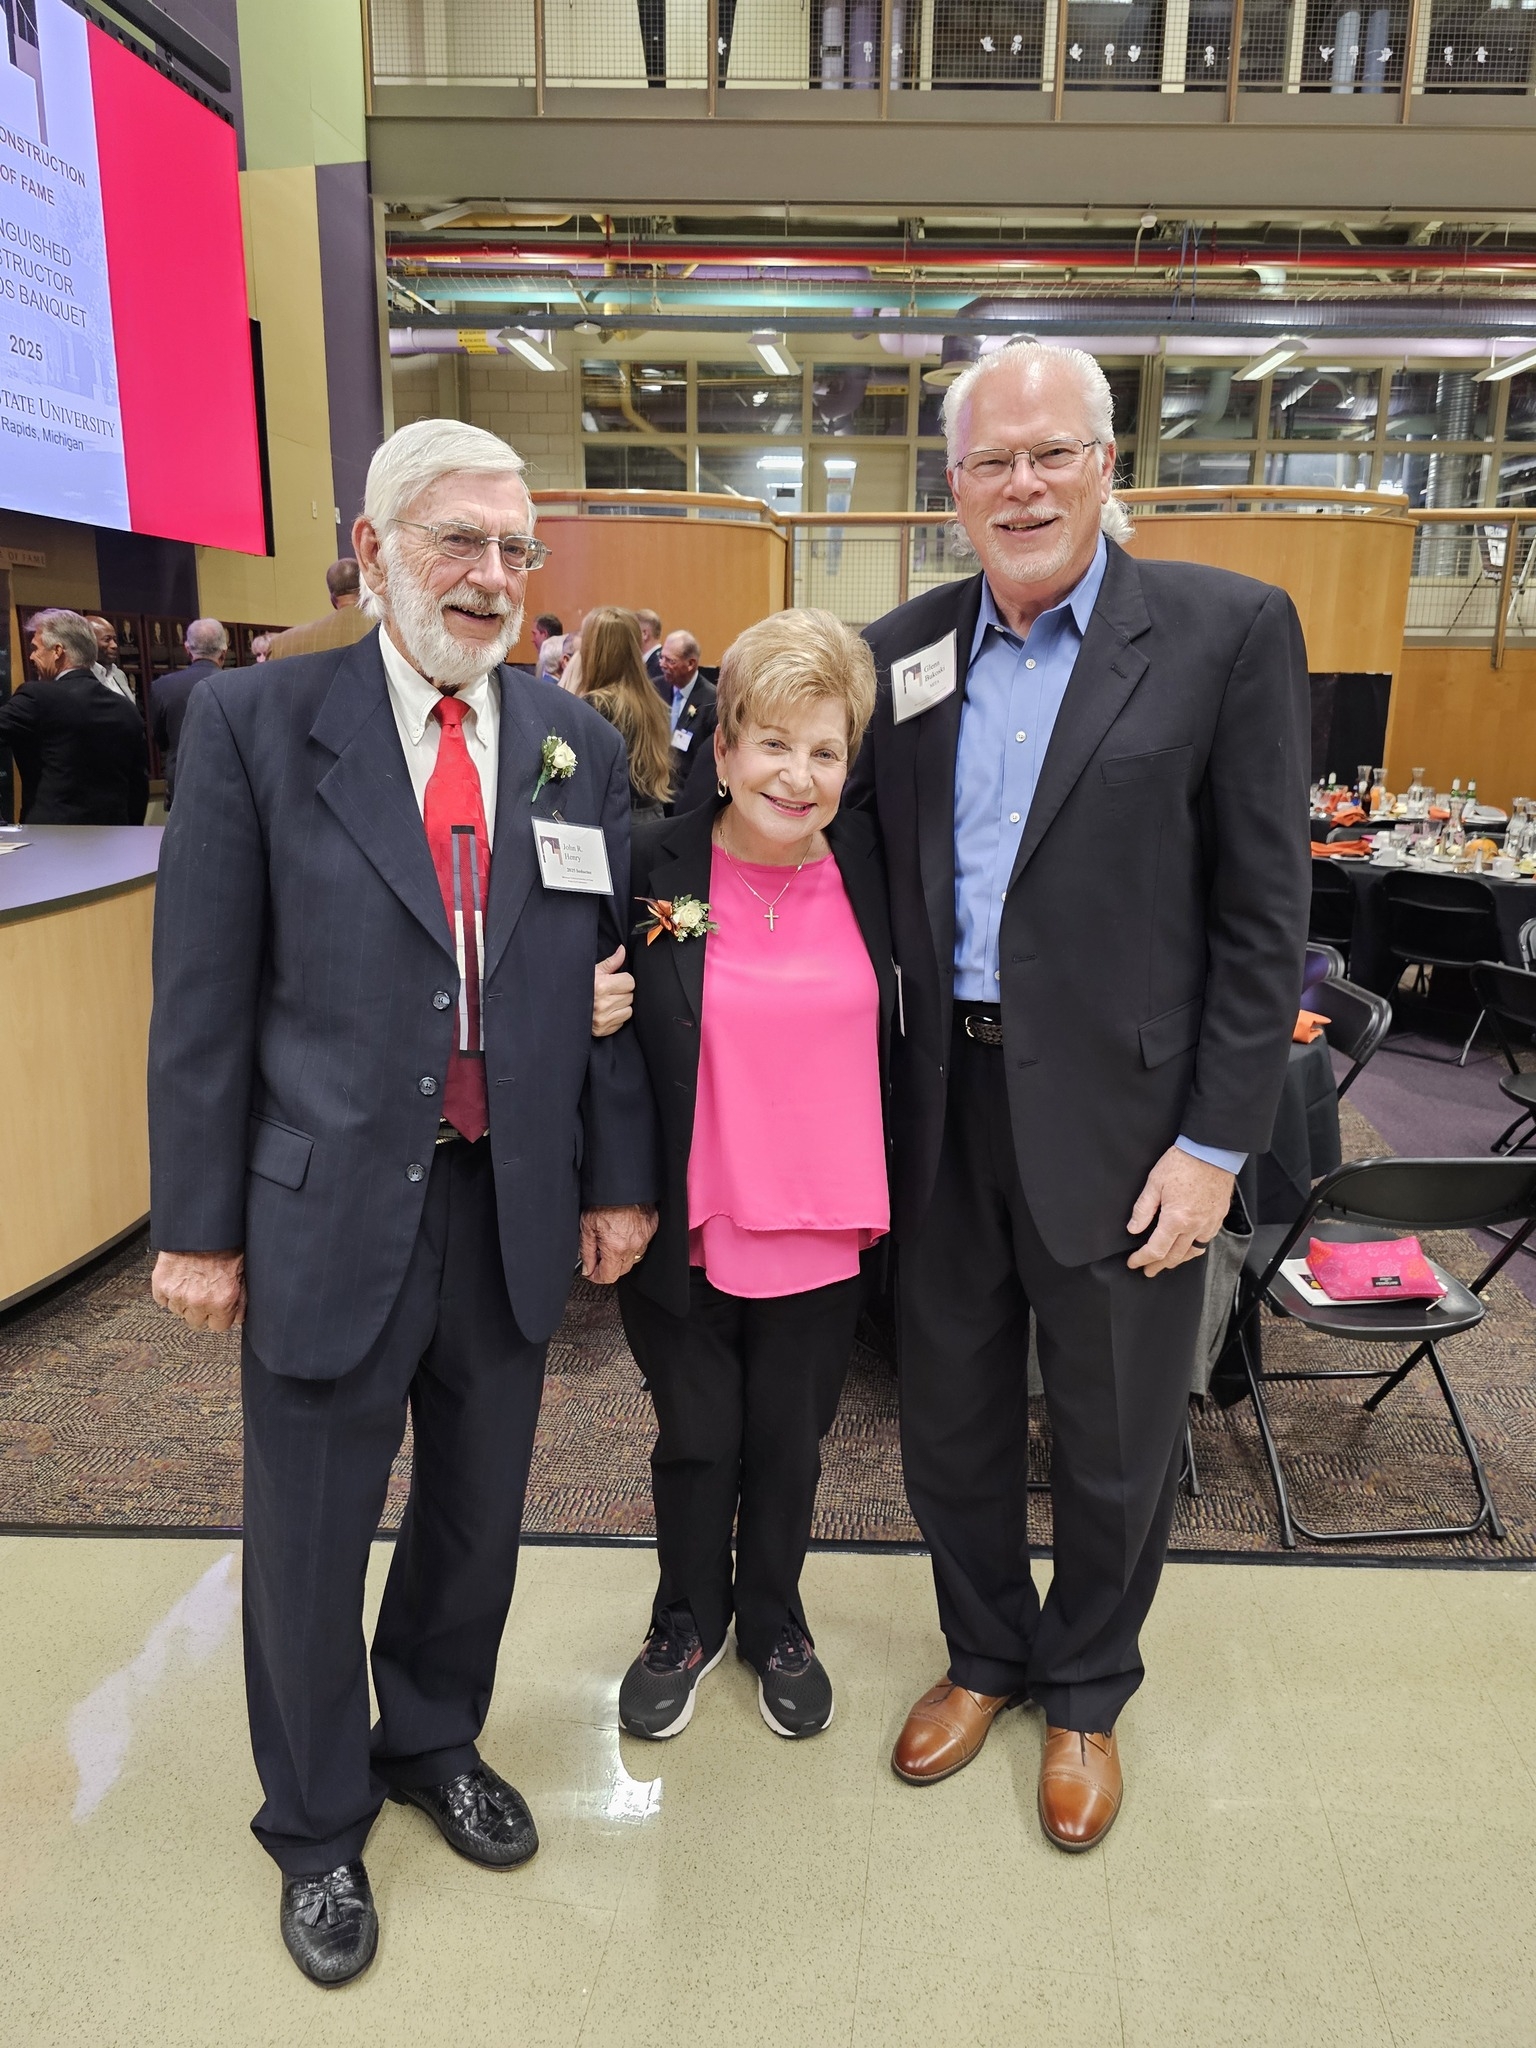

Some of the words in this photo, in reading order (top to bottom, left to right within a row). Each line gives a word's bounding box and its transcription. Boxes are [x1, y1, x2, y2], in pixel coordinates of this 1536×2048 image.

[0, 126, 86, 188] ONSTRUCTION
[0, 164, 17, 185] OF
[21, 174, 55, 206] FAME
[0, 247, 75, 297] TRUCTOR
[19, 283, 87, 328] BANQUET
[9, 334, 43, 361] 2025
[0, 389, 36, 415] TATE
[39, 397, 116, 438] UNIVERSITY
[1, 416, 40, 442] Rapids,
[42, 427, 84, 452] Michigan
